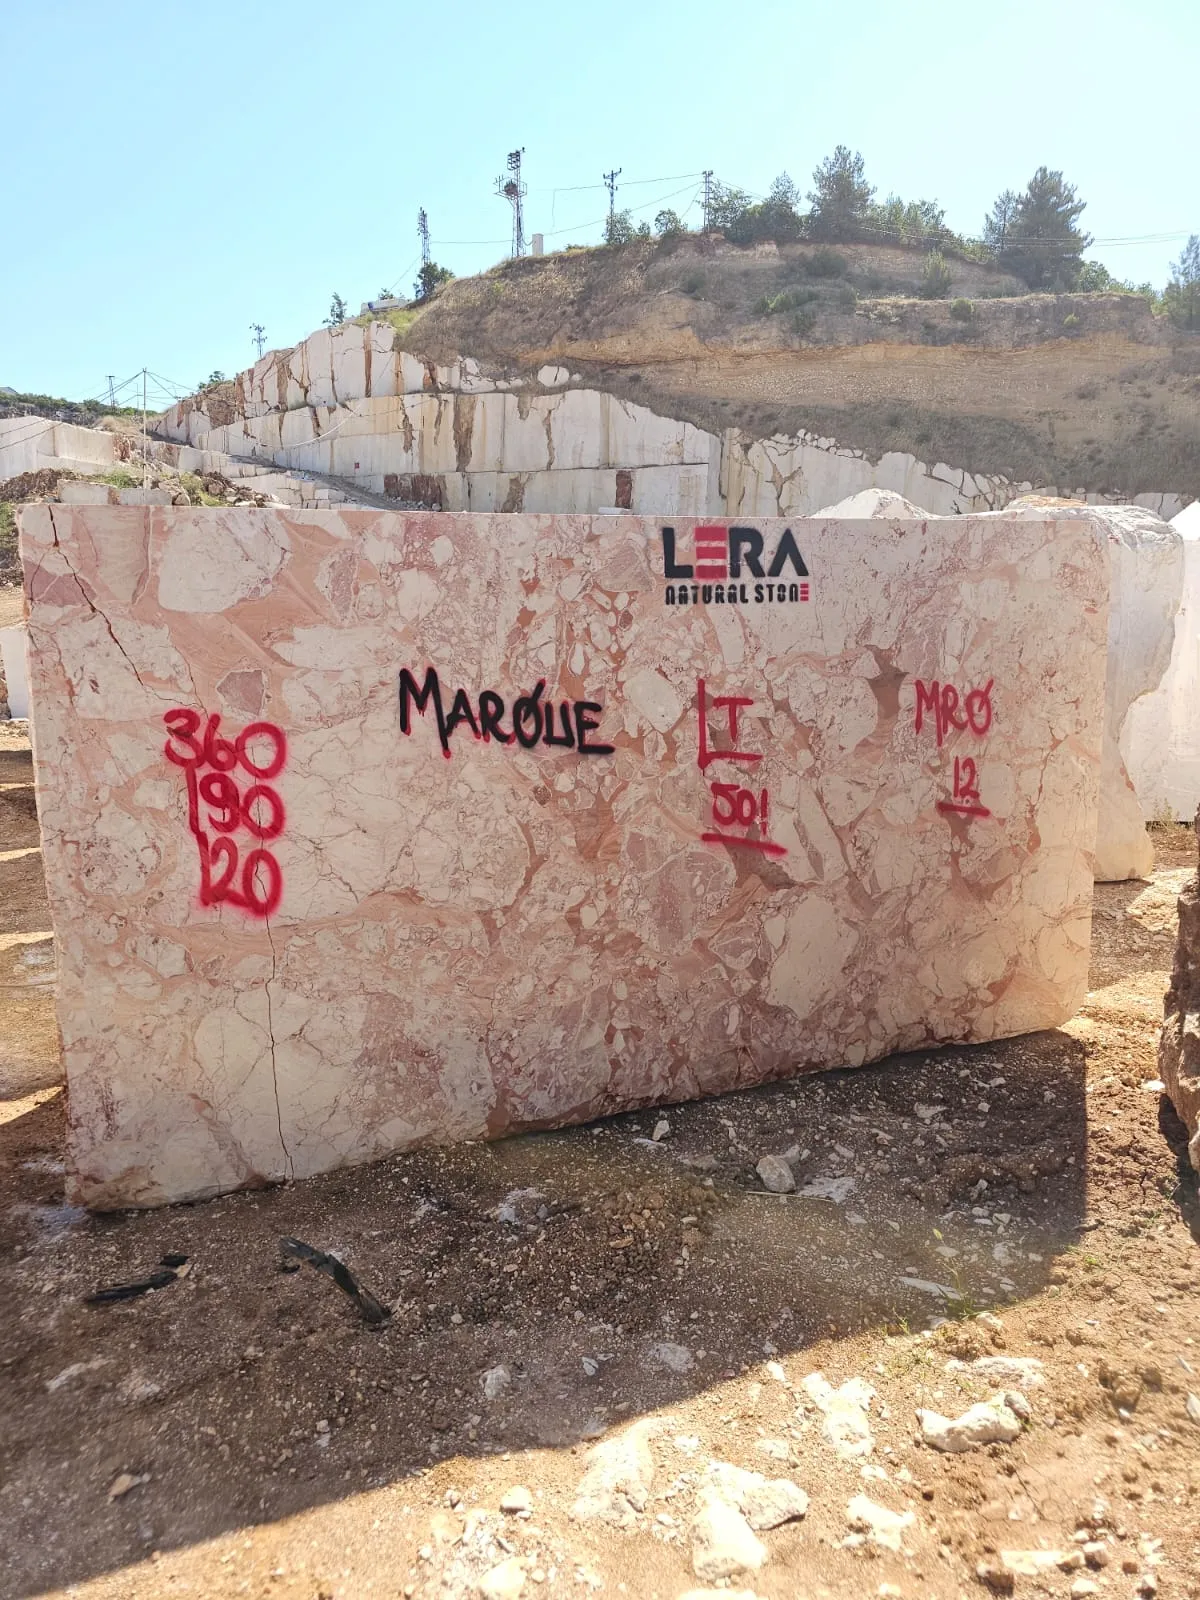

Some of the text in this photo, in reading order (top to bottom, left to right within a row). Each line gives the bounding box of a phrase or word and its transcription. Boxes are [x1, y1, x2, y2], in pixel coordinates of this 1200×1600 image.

[662, 526, 809, 579] LERA
[665, 583, 809, 605] NATURAL STONE
[163, 708, 287, 779] 360
